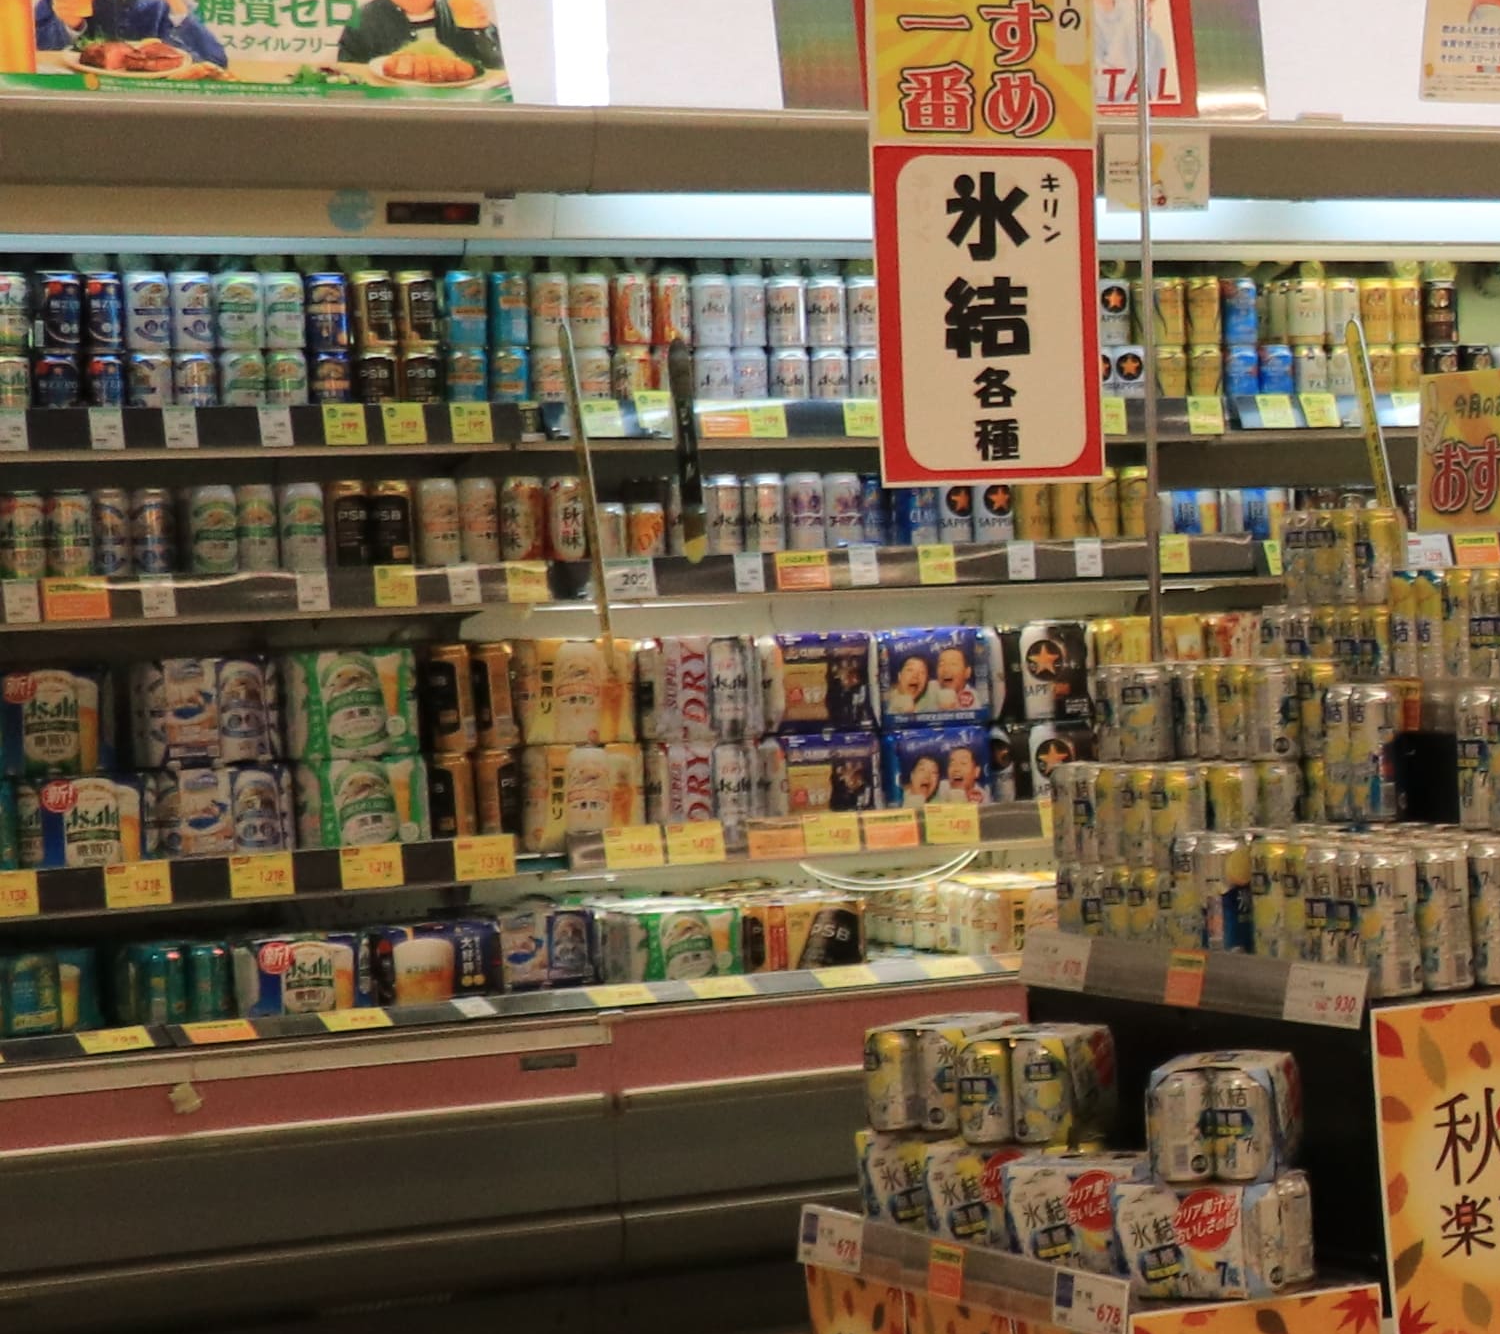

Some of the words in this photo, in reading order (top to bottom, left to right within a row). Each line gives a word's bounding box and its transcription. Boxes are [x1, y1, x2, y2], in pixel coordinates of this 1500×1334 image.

[897, 13, 974, 133] 一番
[1040, 173, 1061, 244] キリン
